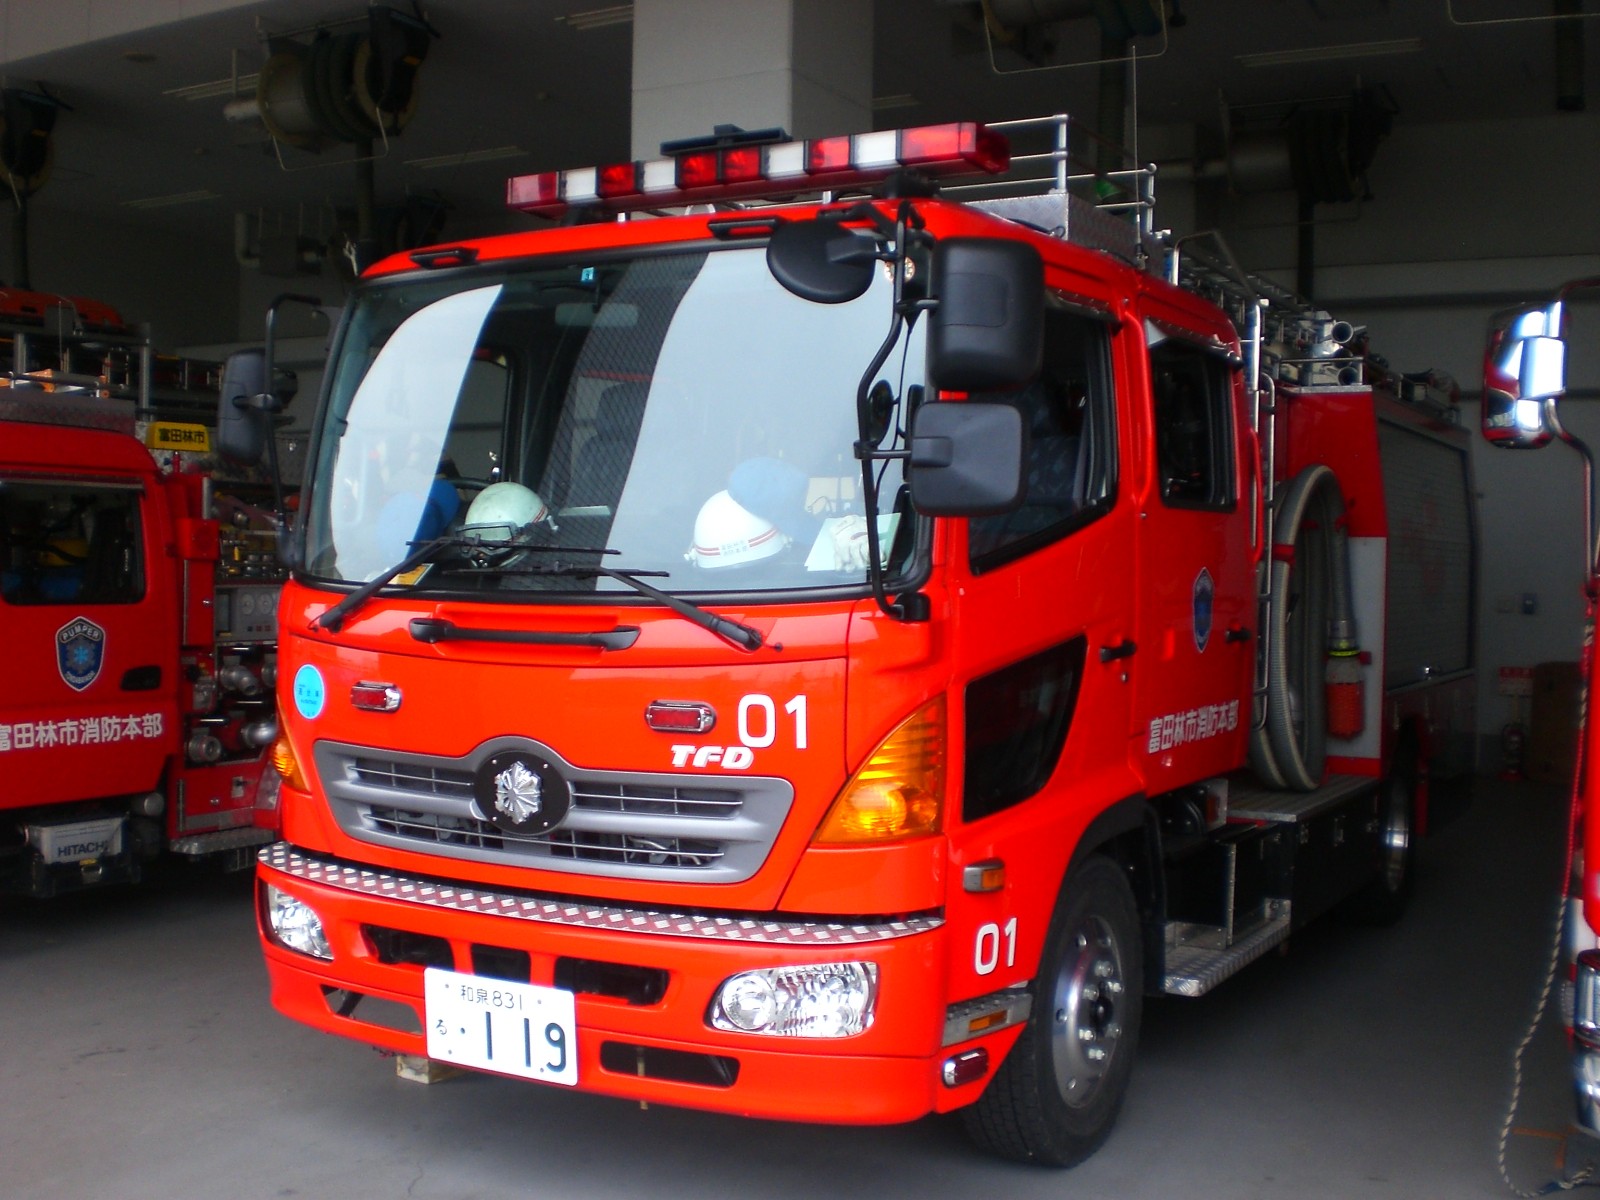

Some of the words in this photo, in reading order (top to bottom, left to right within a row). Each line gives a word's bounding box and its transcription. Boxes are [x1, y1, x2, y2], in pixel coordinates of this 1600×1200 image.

[159, 428, 205, 443] 富田林市
[62, 624, 99, 640] PUMPER
[738, 693, 807, 749] 01
[1148, 700, 1239, 754] 富田林市消防本部
[671, 745, 754, 769] TFD
[974, 917, 1017, 975] 01
